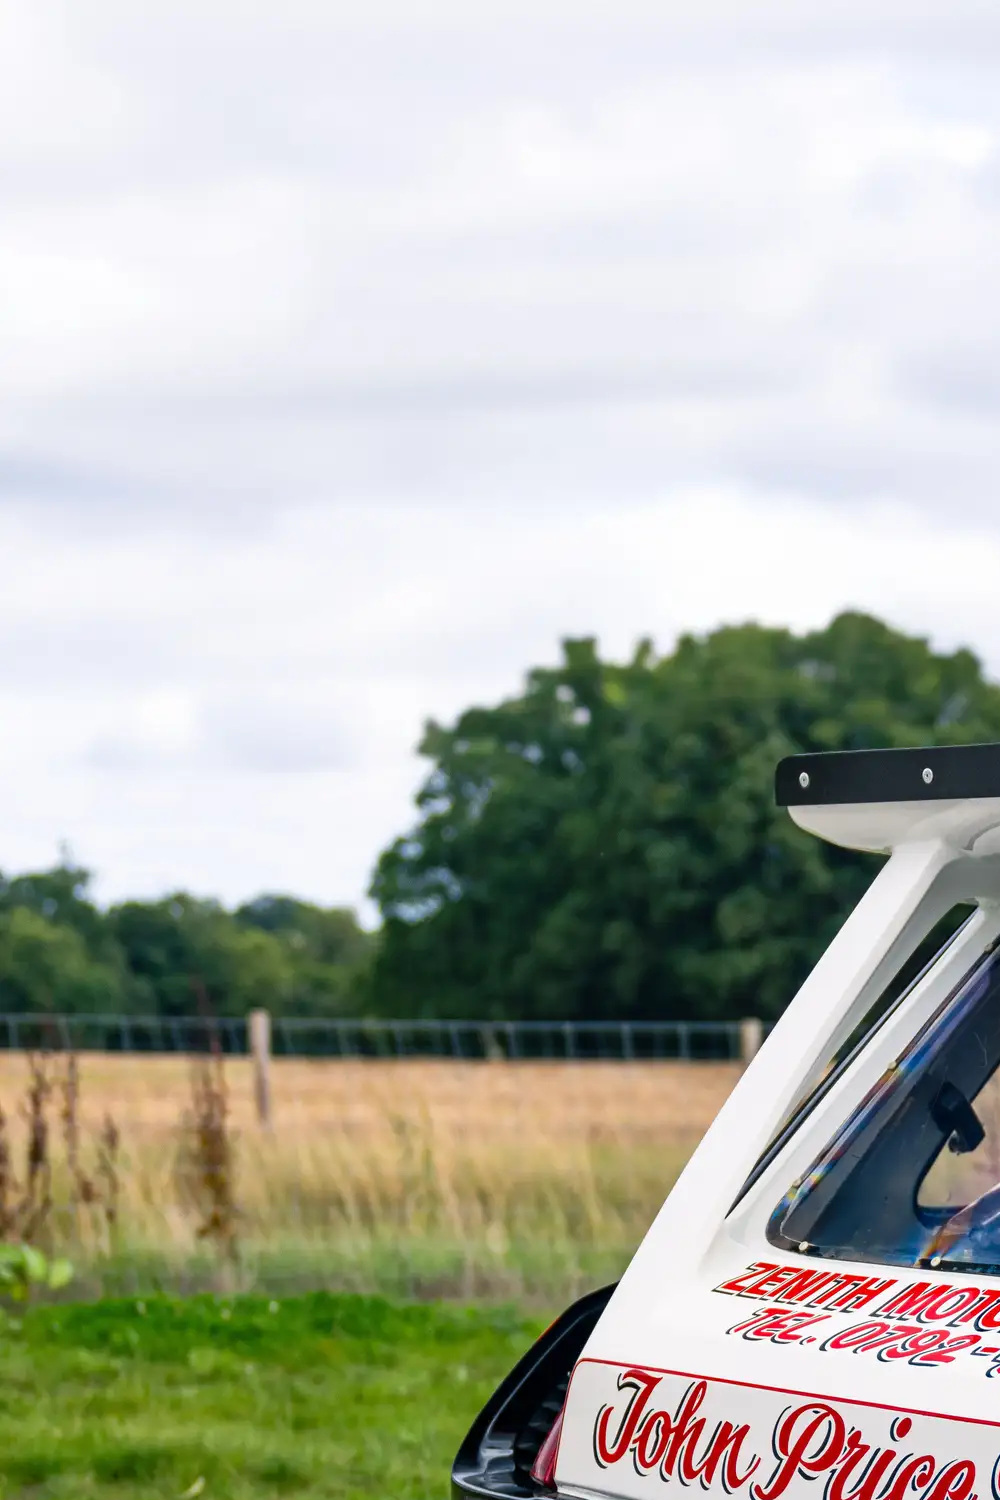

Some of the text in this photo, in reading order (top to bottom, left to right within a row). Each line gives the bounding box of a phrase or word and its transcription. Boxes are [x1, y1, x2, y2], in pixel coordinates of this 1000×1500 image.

[714, 1261, 898, 1313] ZENITH
[726, 1306, 832, 1345] TEL.
[595, 1368, 761, 1493] John
